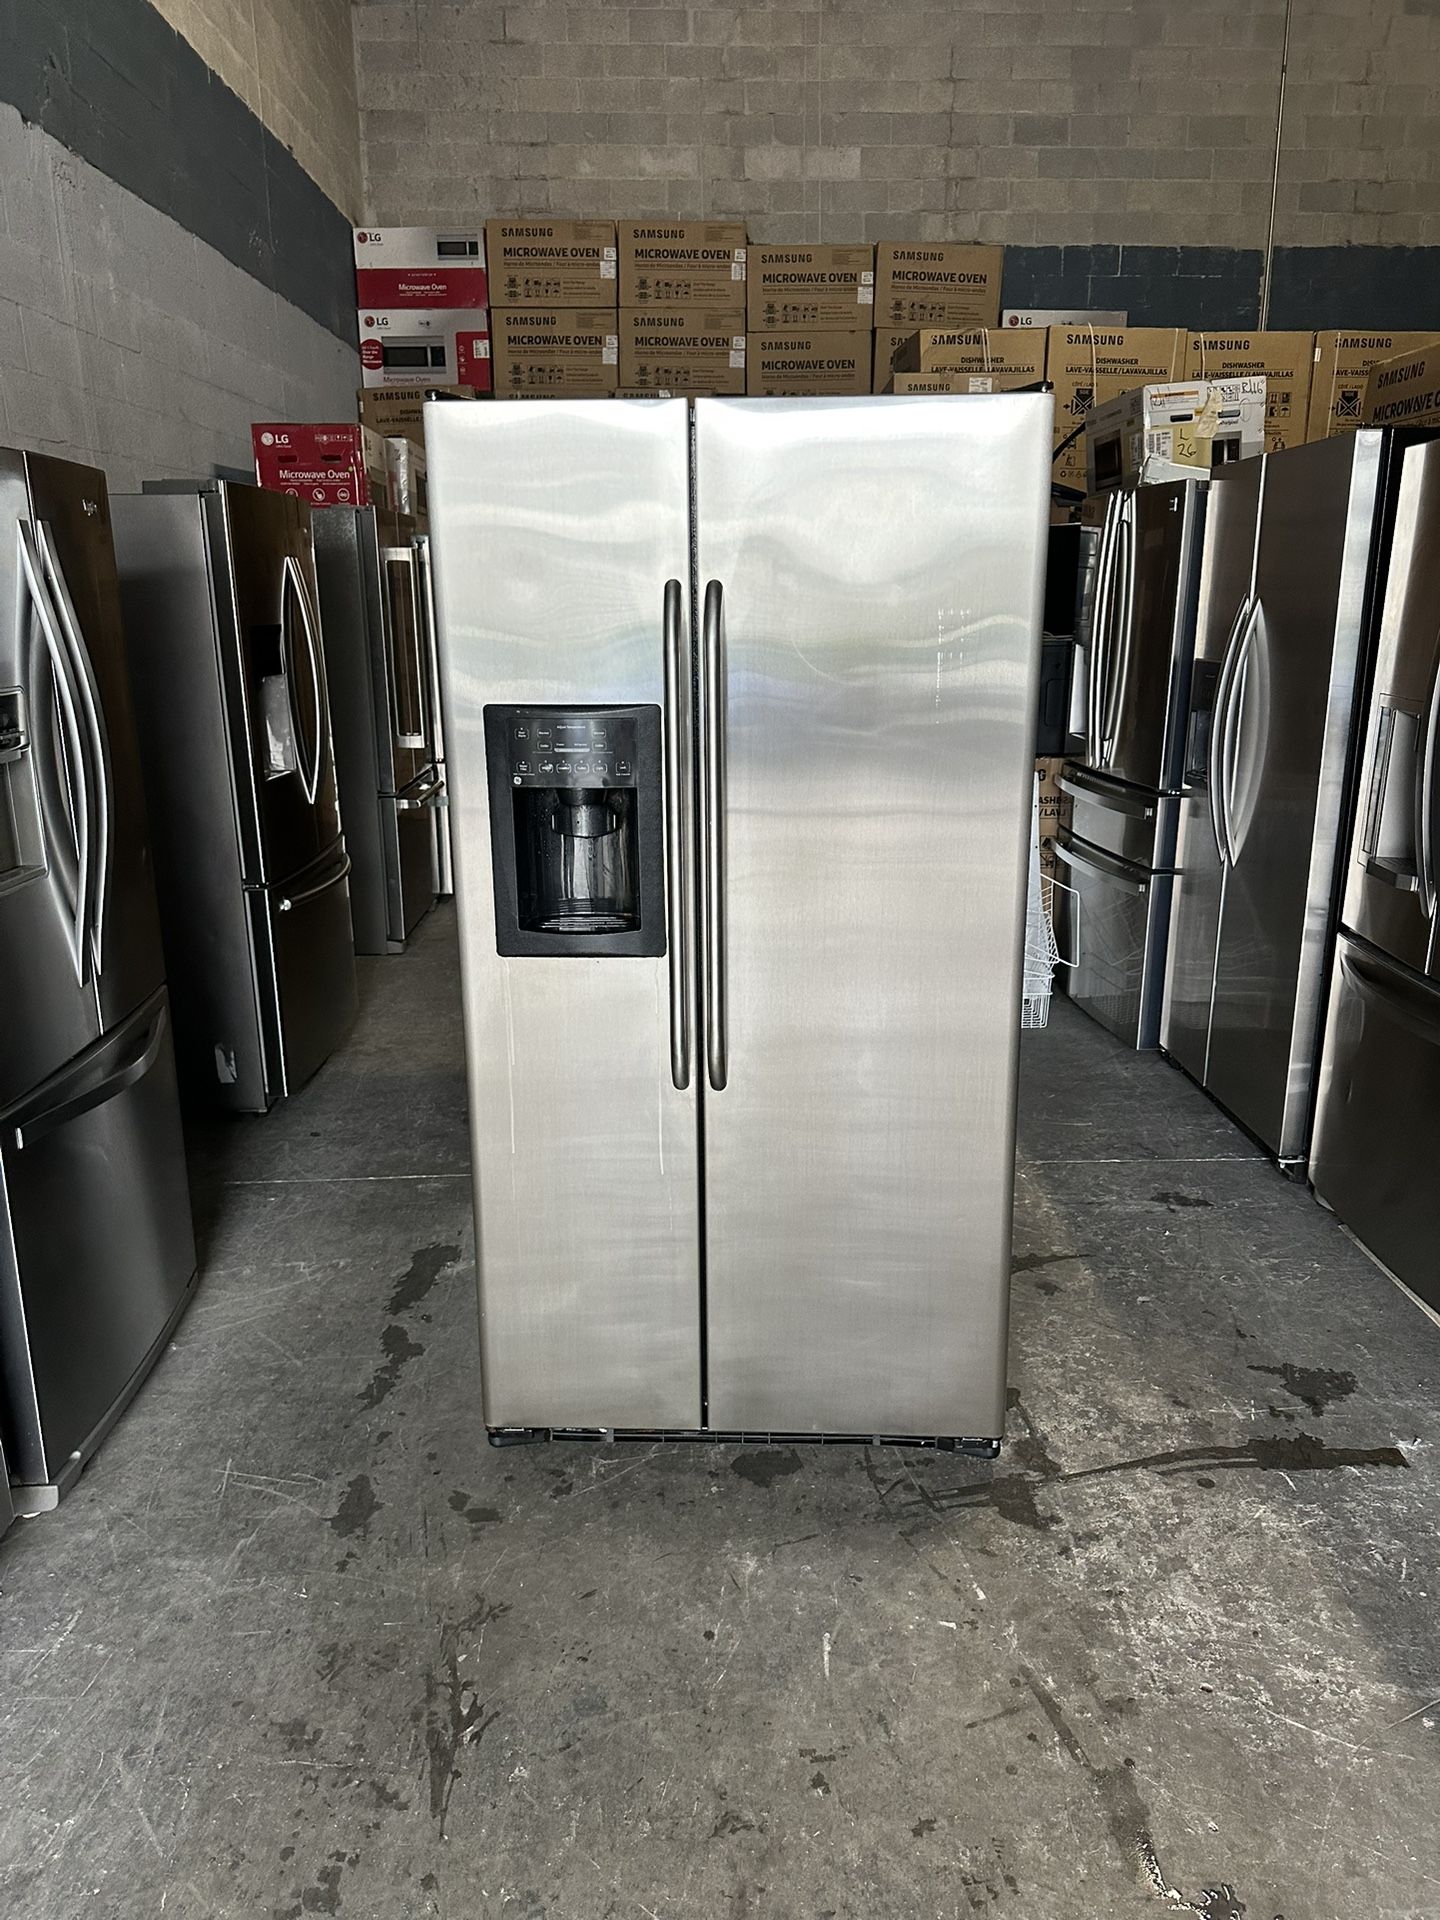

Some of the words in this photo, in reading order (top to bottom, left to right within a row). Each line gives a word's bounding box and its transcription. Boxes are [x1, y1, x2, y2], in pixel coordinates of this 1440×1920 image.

[369, 233, 381, 242] LG
[501, 228, 553, 237] SAMSUNG
[633, 229, 685, 239] SAMSUNG
[503, 247, 568, 257] MICROWAVE
[570, 248, 599, 258] OVEN
[635, 249, 700, 259] MICROWAVE
[702, 250, 731, 260] OVEN
[893, 250, 944, 262] SAMSUNG
[761, 254, 812, 264] SAMSUNG
[762, 273, 826, 283] MICROWAVE
[828, 273, 857, 283] OVEN
[892, 271, 956, 282] MICROWAVE
[958, 273, 987, 284] OVEN
[398, 283, 431, 291] Microwave
[431, 283, 447, 291] Oven
[376, 317, 389, 326] LG
[505, 316, 556, 326] SAMSUNG
[633, 317, 684, 327] SAMSUNG
[1020, 317, 1032, 325] LG
[507, 335, 571, 345] MICROWAVE
[573, 336, 602, 346] OVEN
[635, 336, 698, 347] MICROWAVE
[701, 337, 729, 347] OVEN
[1066, 334, 1124, 346] SAMSUNG
[1335, 338, 1392, 348] SAMSUNG
[761, 341, 811, 351] SAMSUNG
[761, 360, 825, 370] MICROWAVE
[826, 359, 855, 369] OVEN
[1096, 357, 1139, 365] DISHWASHER
[1065, 366, 1168, 376] LAVE-VASSELLE/LAVAVAJILLAS
[1377, 361, 1425, 389] SAMSUNG
[907, 383, 951, 392] SAMSUNG
[372, 391, 420, 401] SAMSUNG
[1373, 391, 1433, 423] MICROWAVE
[275, 434, 289, 444] LG
[279, 470, 326, 479] Microwave
[327, 469, 350, 478] Oven
